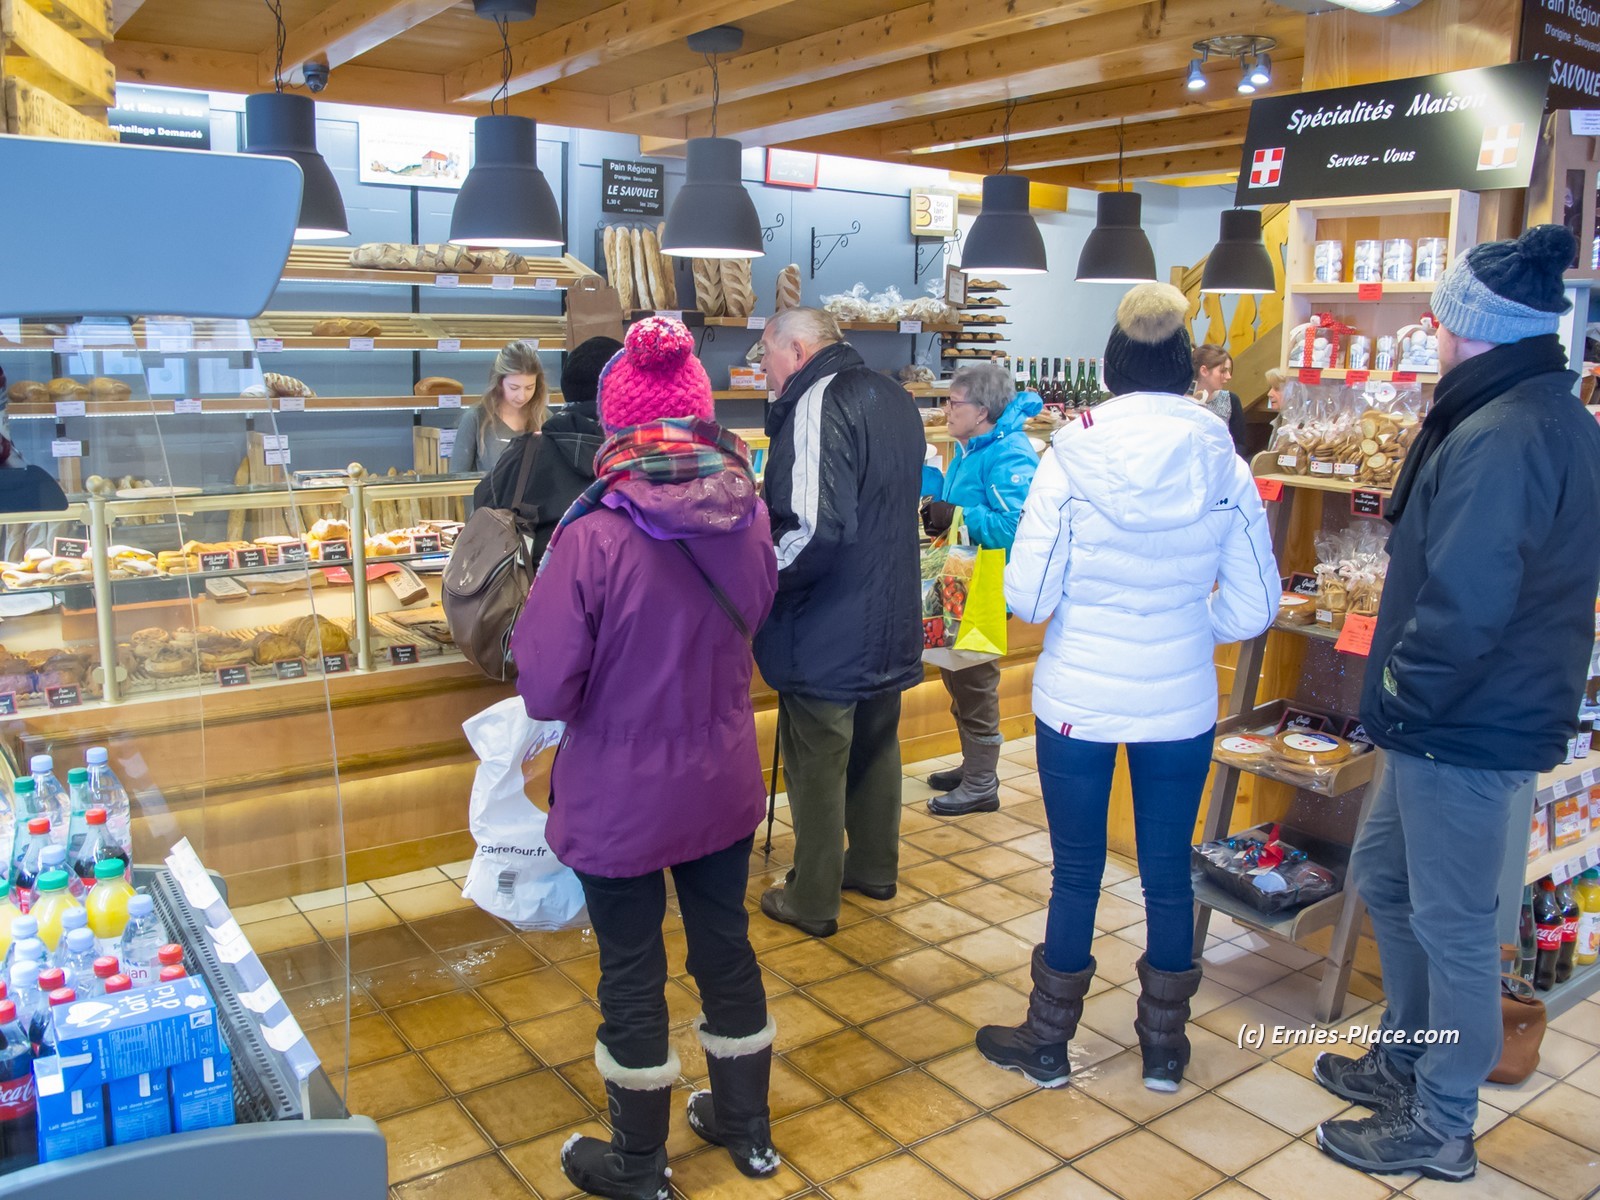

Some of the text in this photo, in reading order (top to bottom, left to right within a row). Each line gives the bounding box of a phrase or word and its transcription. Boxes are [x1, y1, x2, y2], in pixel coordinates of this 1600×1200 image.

[1568, 0, 1600, 27] Région
[1545, 23, 1600, 53] D'origine Savoyar
[1550, 59, 1600, 97] SAVOUE
[1286, 91, 1487, 135] Spécialités Maison
[109, 124, 203, 139] mballage Demandé
[610, 162, 657, 174] Pain Régional
[1326, 152, 1368, 169] Servez
[1383, 148, 1416, 165] Vous
[607, 184, 659, 198] LE SAVOUET
[481, 843, 547, 857] carrefour.fr
[118, 993, 150, 1019] lait
